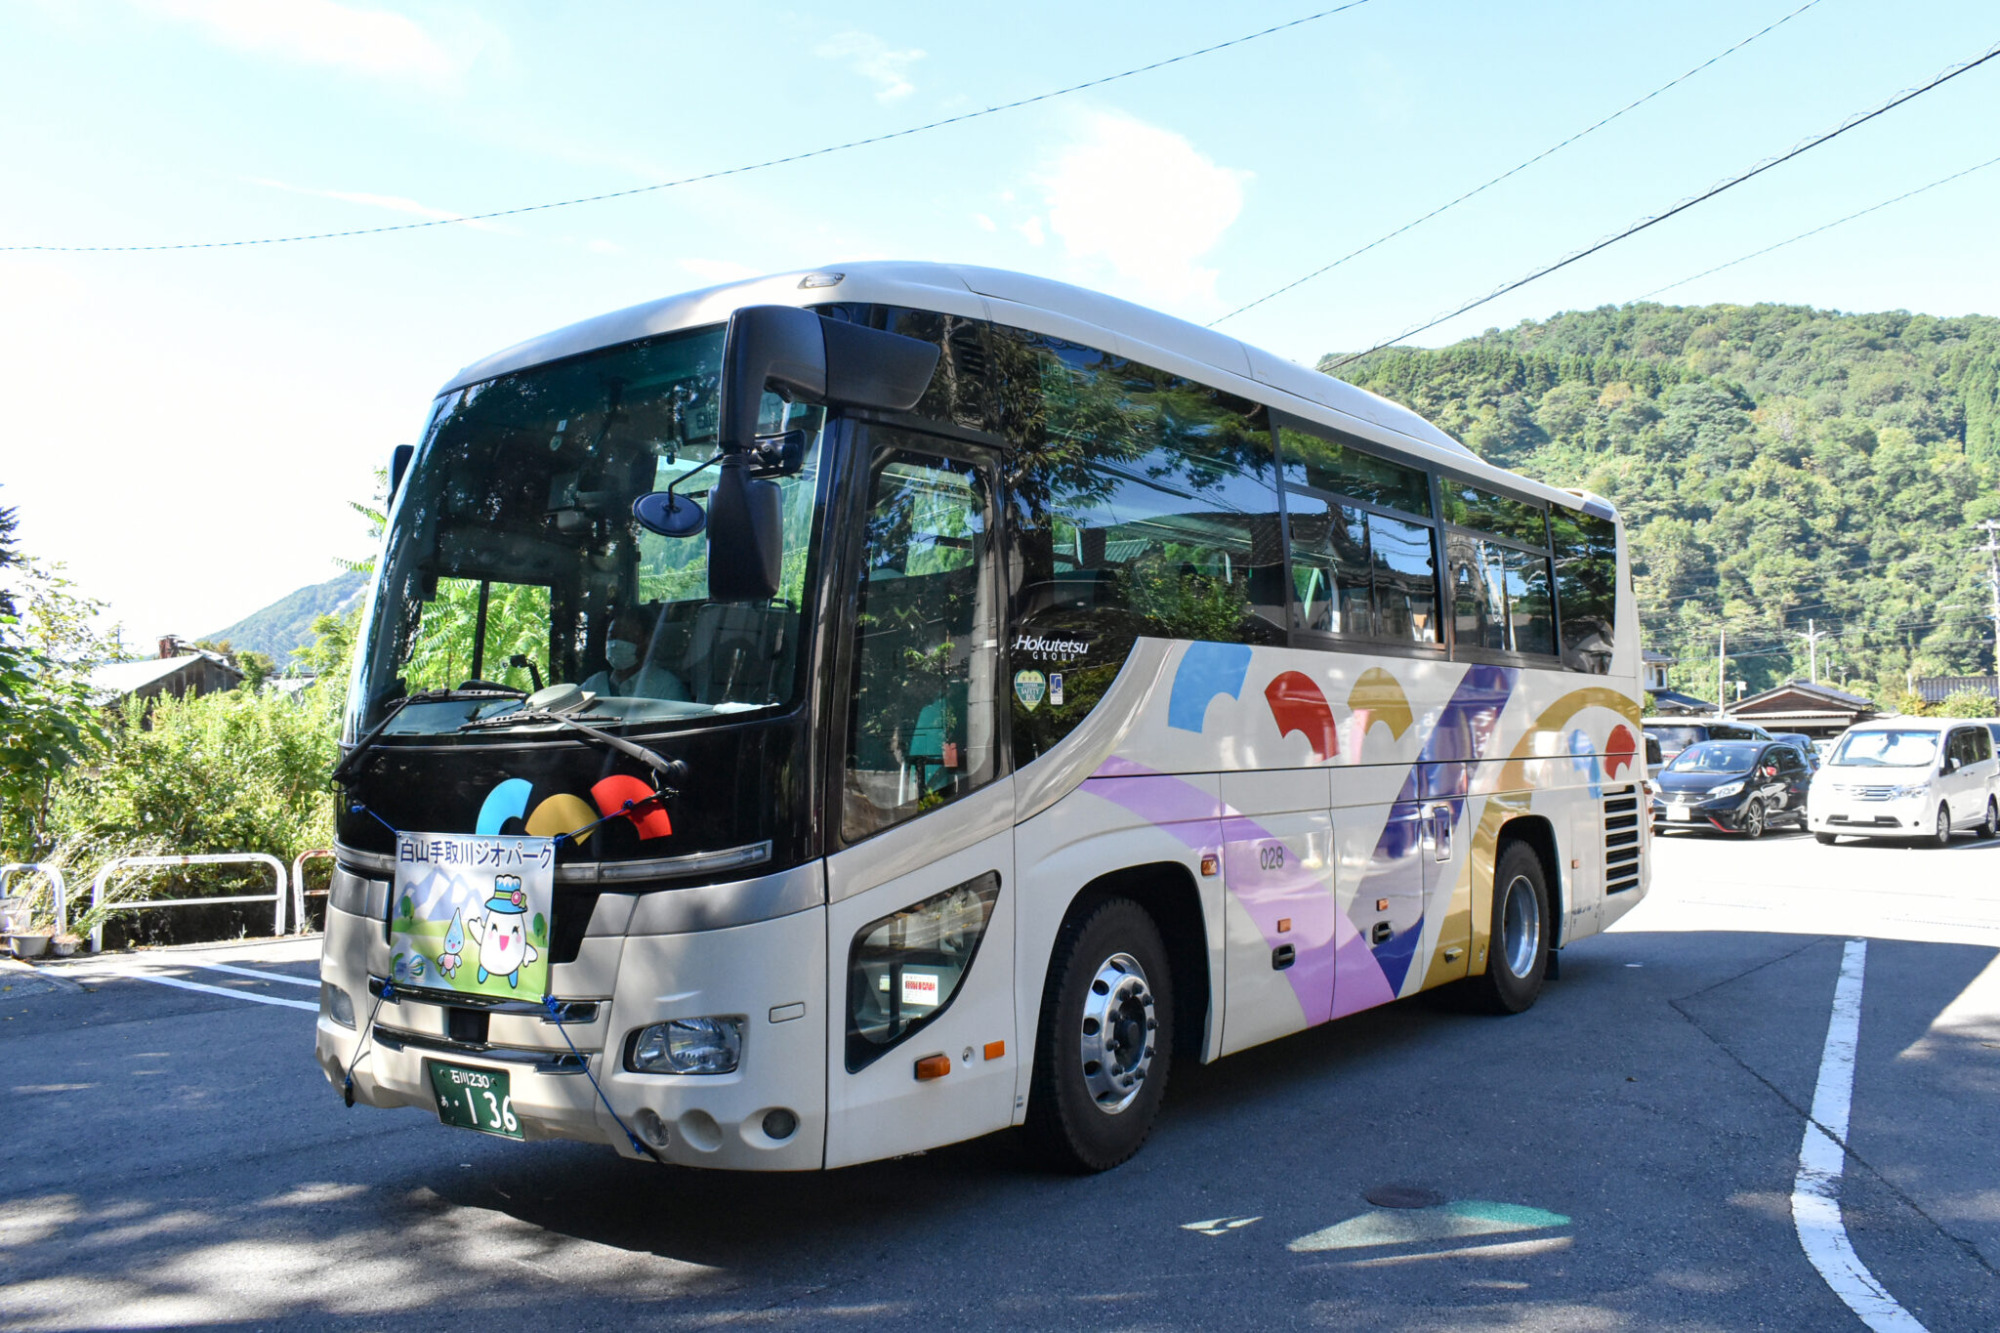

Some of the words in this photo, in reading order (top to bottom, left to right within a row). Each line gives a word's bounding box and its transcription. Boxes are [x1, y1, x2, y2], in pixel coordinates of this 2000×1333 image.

[1015, 635, 1089, 654] Hokutetsu
[1032, 651, 1075, 661] GROUP
[400, 839, 552, 869] 白山手取川ジオパーク
[1260, 846, 1284, 870] 028
